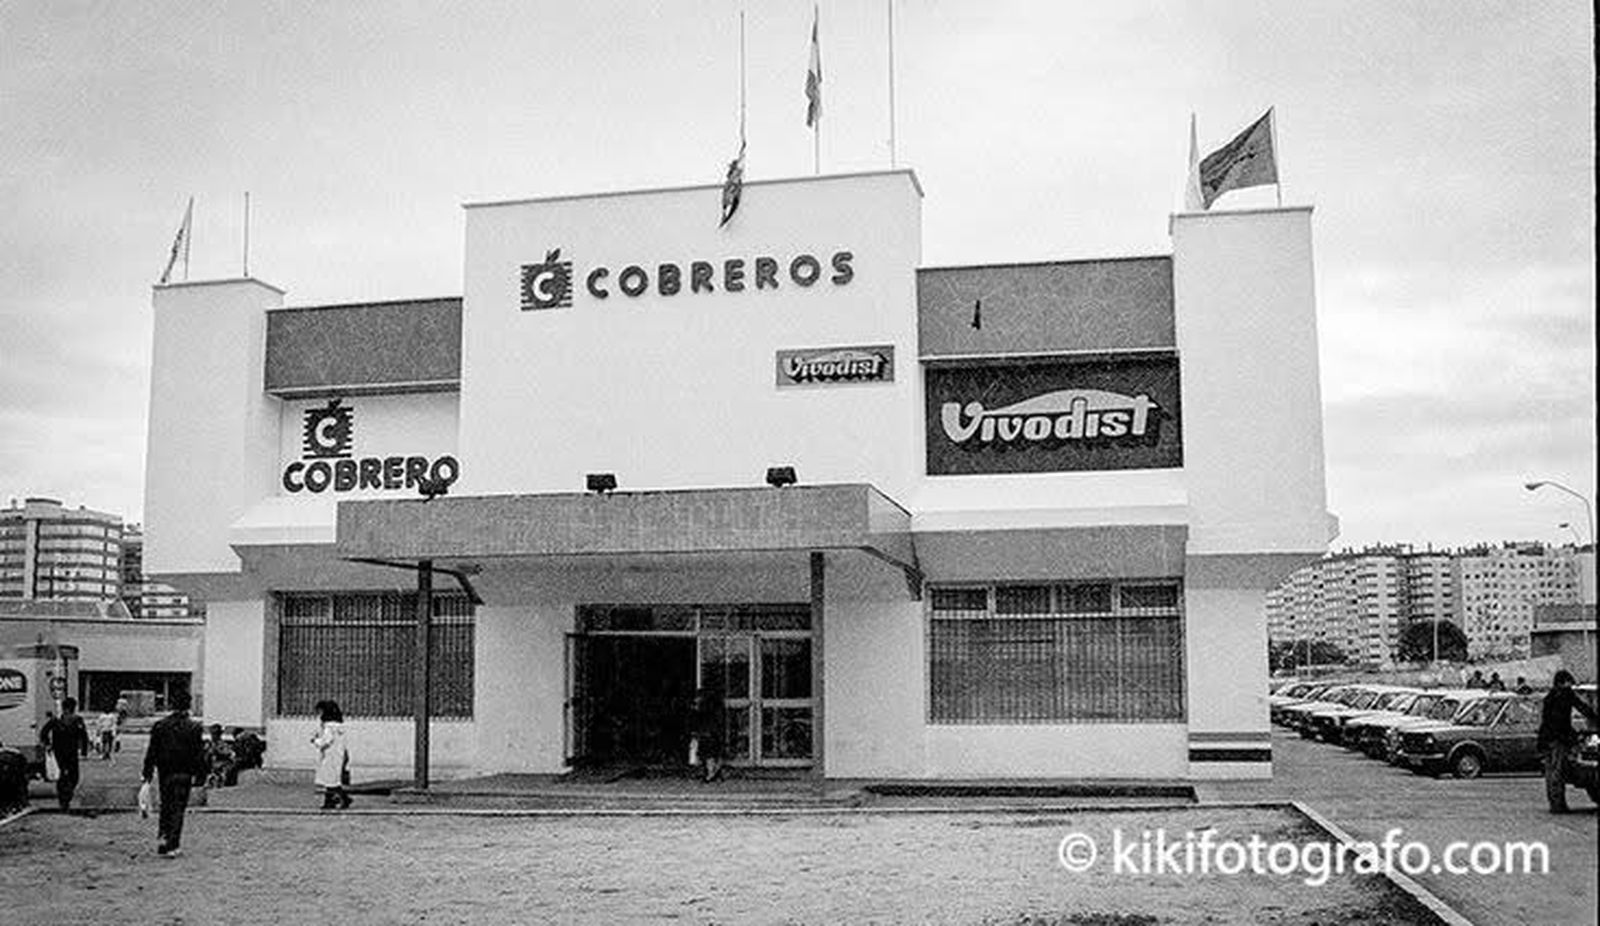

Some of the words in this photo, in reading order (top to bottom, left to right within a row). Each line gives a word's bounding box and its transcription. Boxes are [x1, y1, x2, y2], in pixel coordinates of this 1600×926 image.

[586, 251, 855, 300] COBREROS
[782, 353, 884, 378] Vivodist
[315, 416, 337, 448] C
[941, 394, 1158, 443] Vivodist
[283, 456, 459, 494] COBRERO
